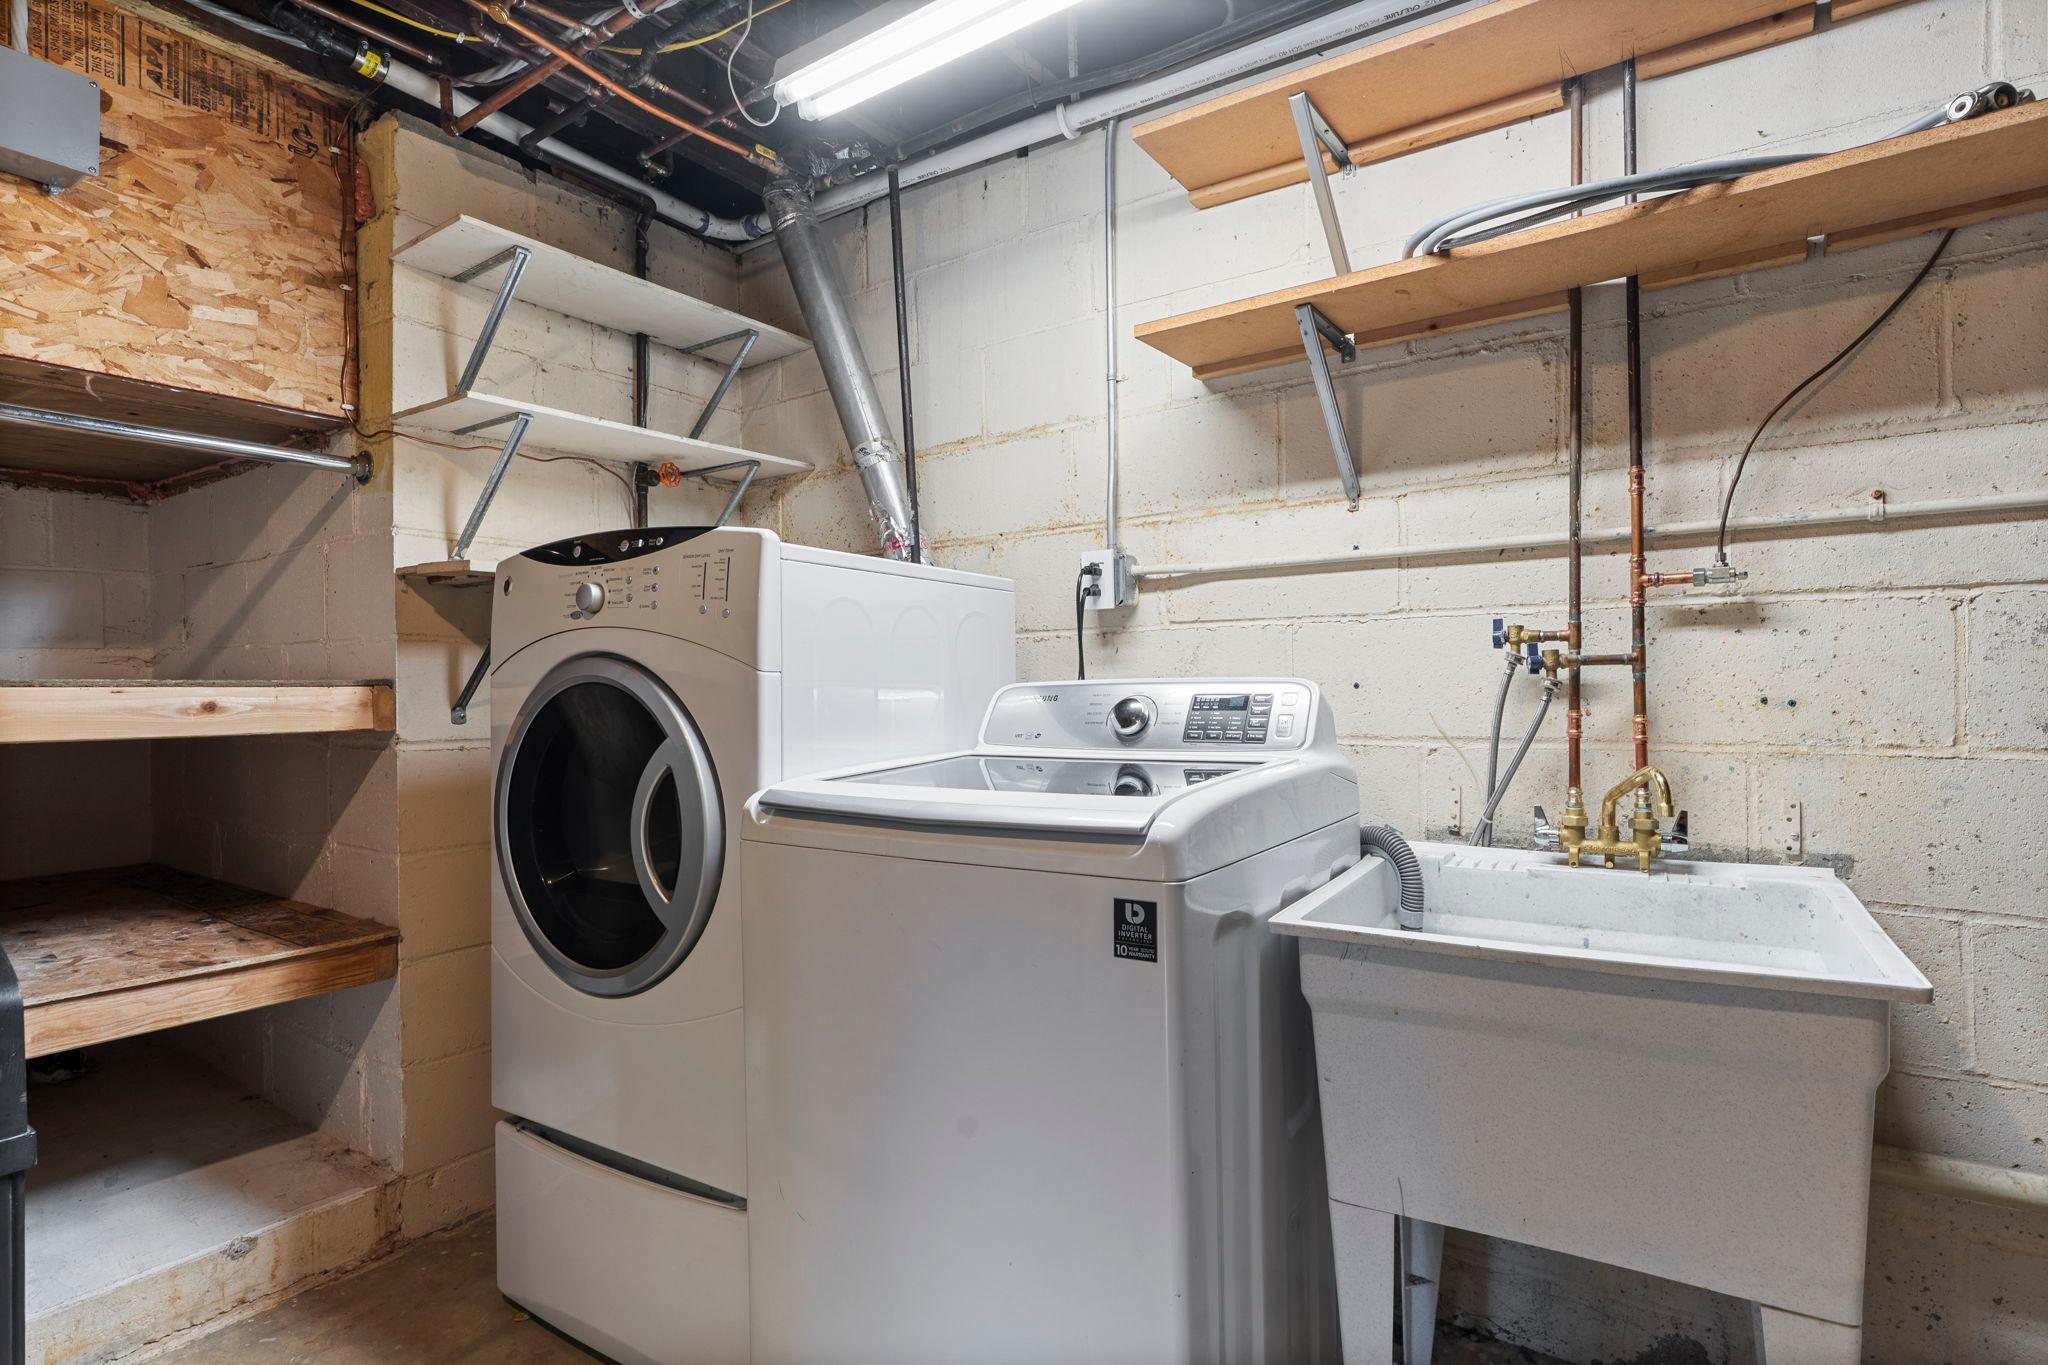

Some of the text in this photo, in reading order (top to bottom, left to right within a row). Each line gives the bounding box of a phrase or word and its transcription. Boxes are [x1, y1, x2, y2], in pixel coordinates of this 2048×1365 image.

[61, 19, 71, 29] AT
[73, 25, 83, 36] AT
[49, 30, 60, 52] SPACE
[62, 31, 72, 48] INCH
[73, 37, 84, 54] INCH
[90, 7, 102, 73] THIS SIDE DOWN
[104, 38, 114, 59] LADO
[104, 58, 114, 80] ESTE
[147, 35, 163, 89] APA
[1118, 931, 1152, 940] INVERTER
[1121, 924, 1148, 933] DIGITAL
[1116, 944, 1128, 956] 10
[1128, 951, 1156, 959] WARRANTY
